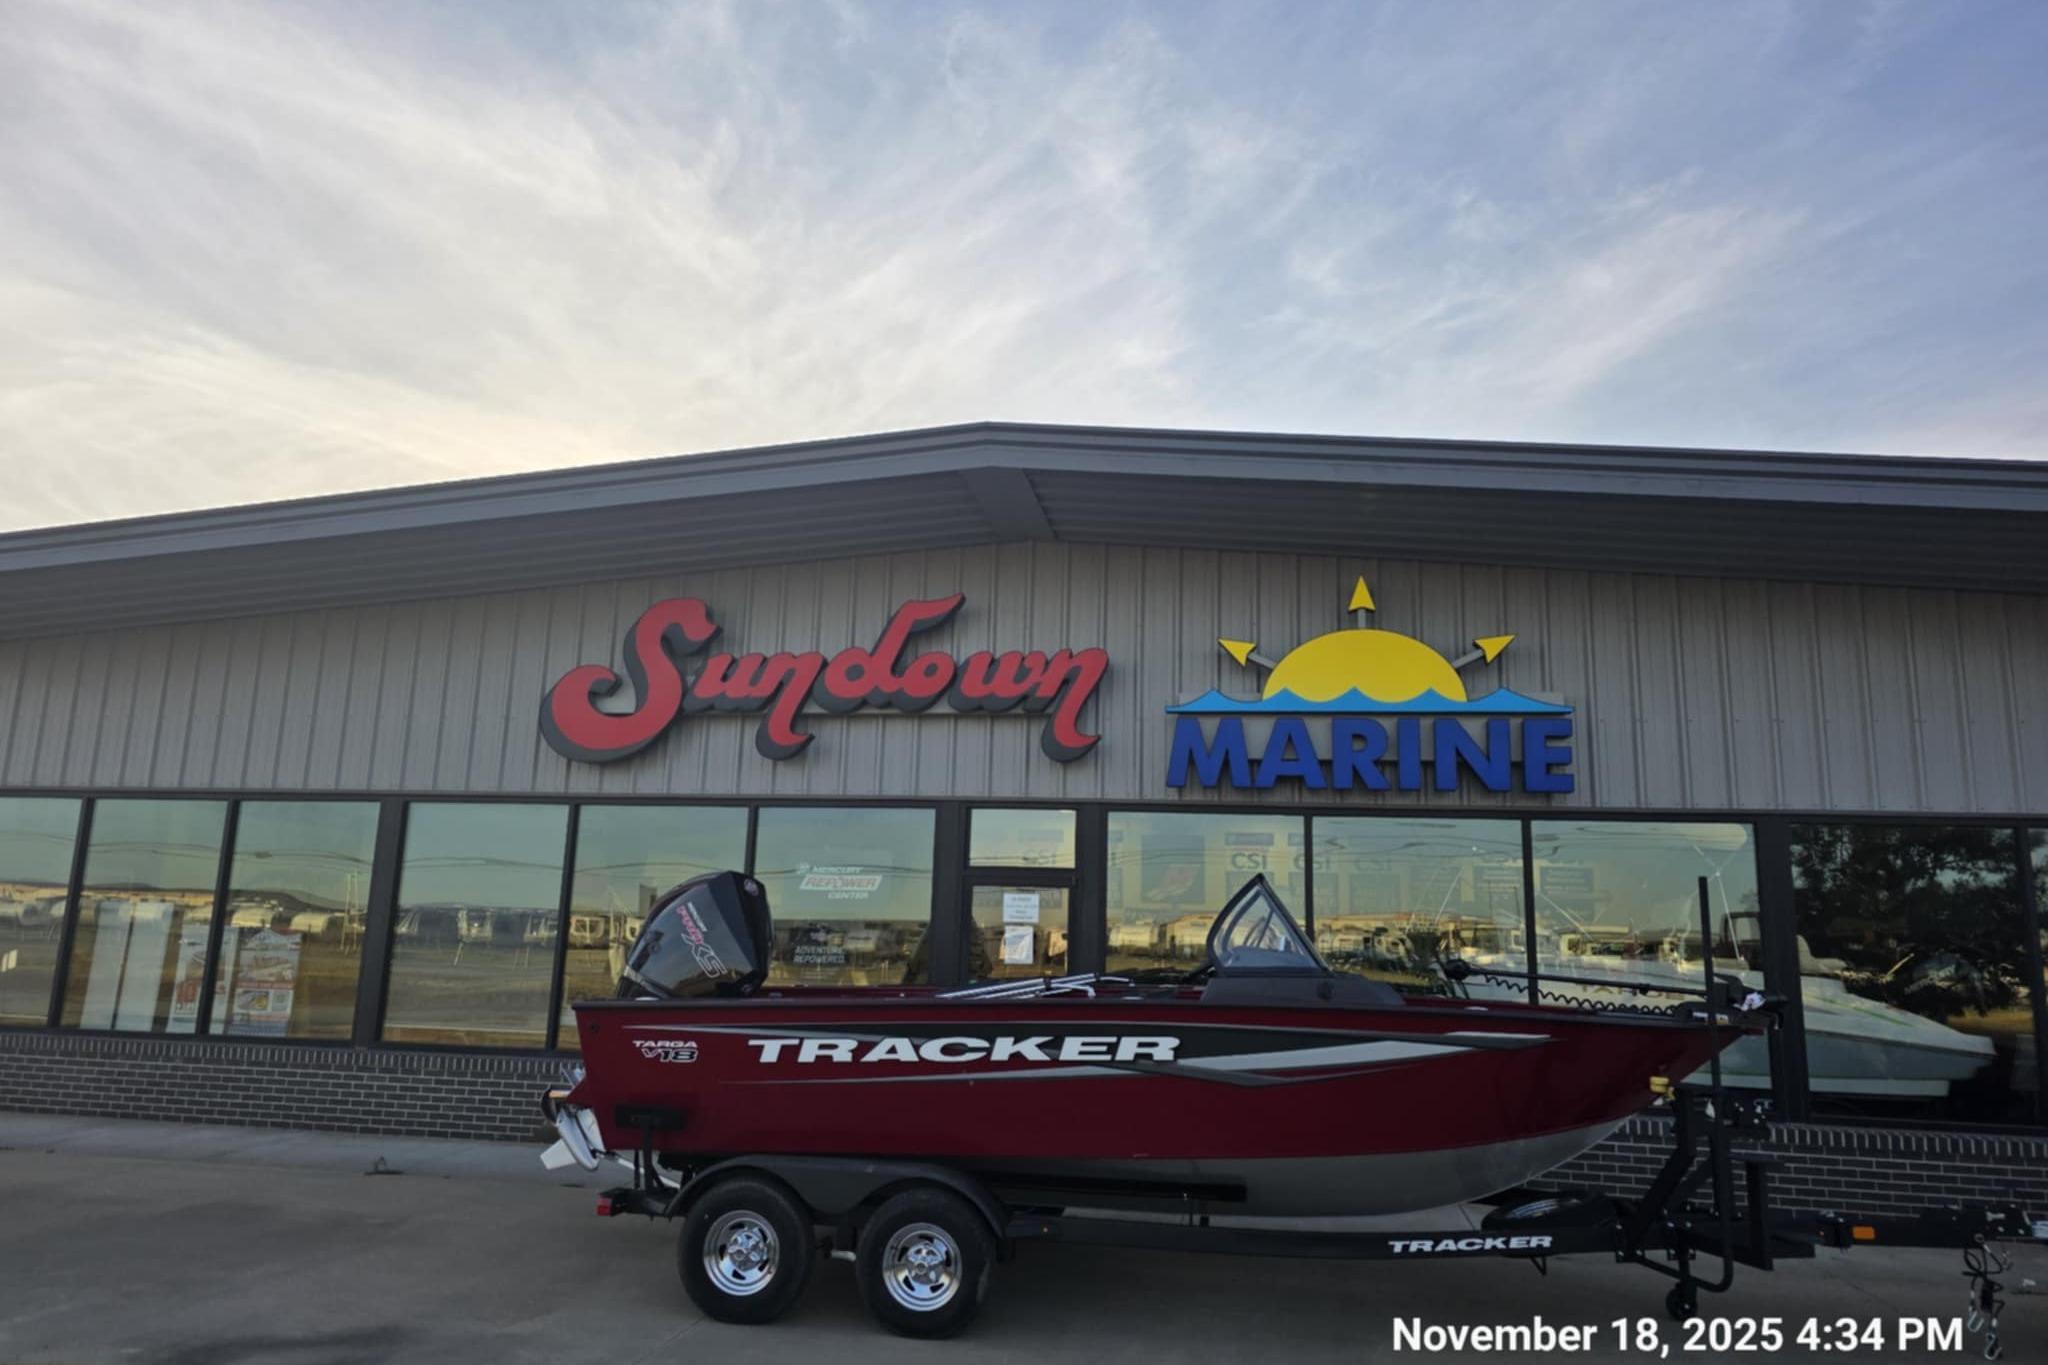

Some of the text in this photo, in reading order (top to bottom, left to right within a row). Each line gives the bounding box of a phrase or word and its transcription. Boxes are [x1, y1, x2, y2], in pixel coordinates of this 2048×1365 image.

[541, 593, 1109, 763] Sundown
[1167, 716, 1575, 795] MARINE
[1231, 853, 1268, 869] CSI
[812, 866, 863, 874] MERCURY
[805, 875, 877, 888] REPOWER
[828, 891, 869, 899] CENTER
[632, 1040, 698, 1048] TARGA
[748, 1036, 1181, 1063] TRACKER
[641, 1048, 698, 1063] V18
[1388, 1235, 1553, 1253] TRACKER
